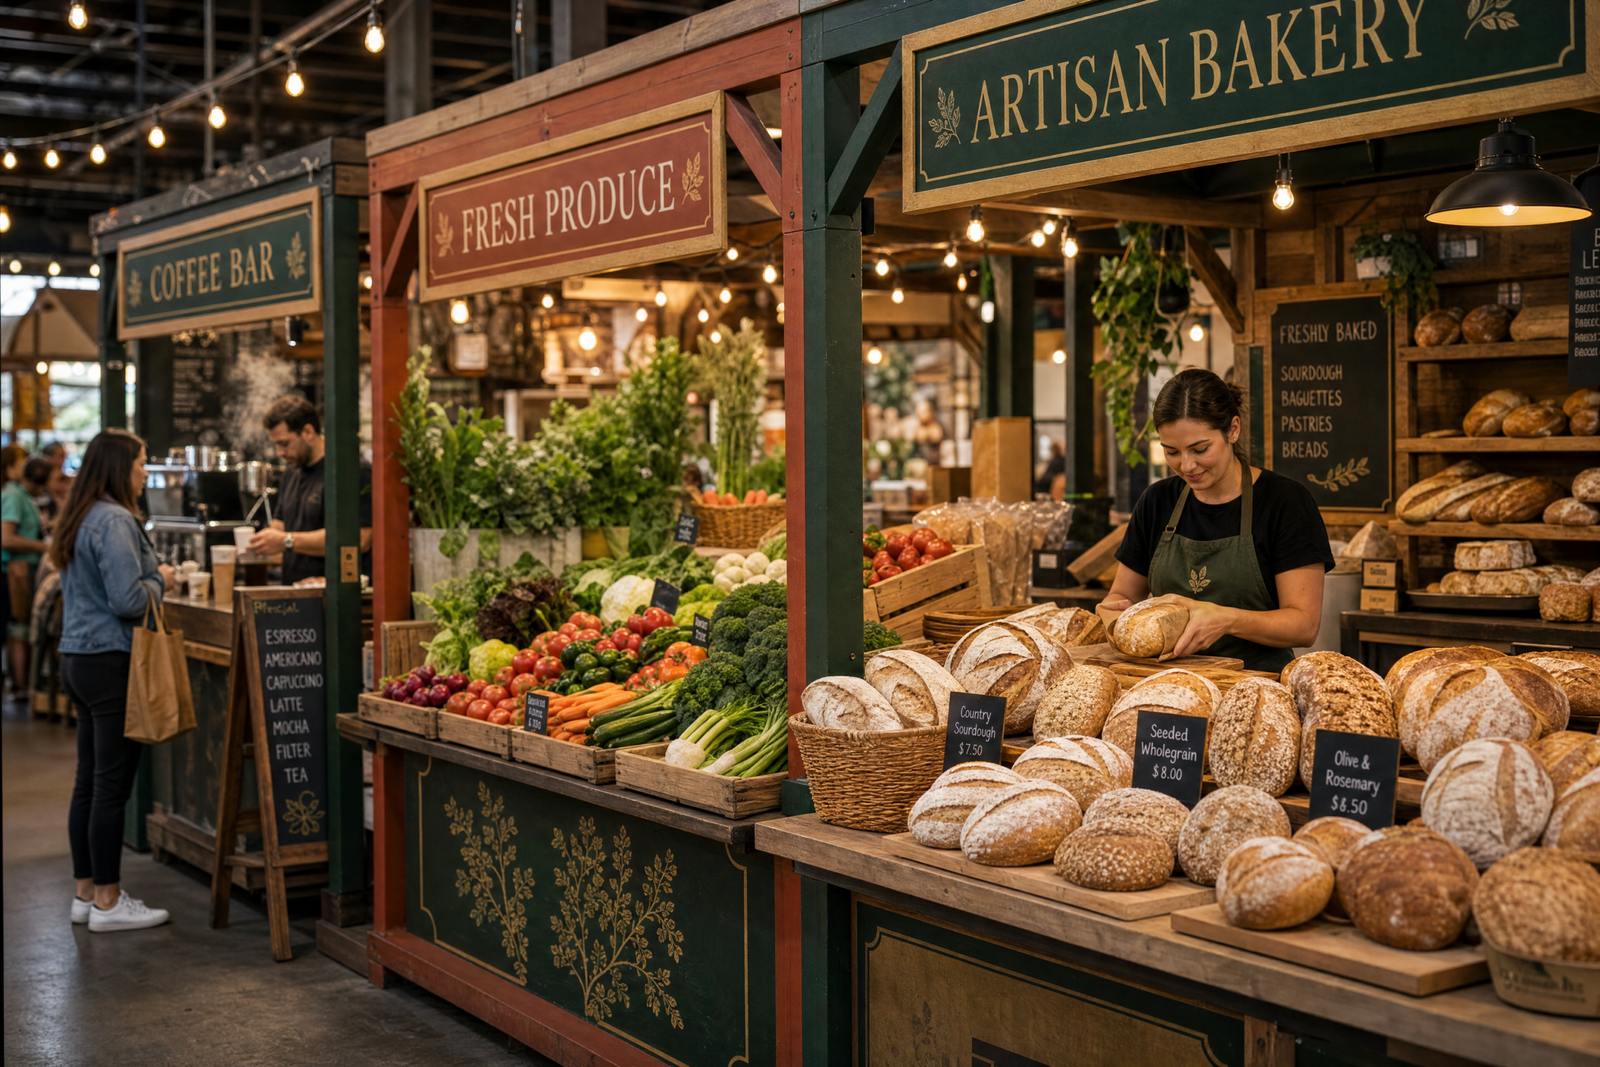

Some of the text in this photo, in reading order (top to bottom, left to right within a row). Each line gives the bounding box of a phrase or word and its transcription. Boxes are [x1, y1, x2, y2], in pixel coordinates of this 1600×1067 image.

[970, 0, 1425, 143] ARTISAN BAKERY
[461, 160, 675, 254] FRESH PRODUCE
[149, 241, 275, 303] COFFEE BAR
[1280, 321, 1377, 344] FRESHLY BAKED
[1281, 365, 1342, 381] SOURDOUGH
[1282, 390, 1342, 406] BAGUETTES
[1282, 416, 1332, 432] PASTRIES
[1283, 441, 1328, 458] BREADS
[265, 628, 316, 645] ESPRESSO
[265, 651, 321, 667] AMERICANO
[266, 674, 323, 690] CAPPUCCINO
[270, 697, 303, 713] LATTE
[960, 705, 992, 725] Country
[273, 719, 309, 735] MOCHA
[953, 721, 996, 742] Sourdough
[1150, 723, 1189, 743] Seeded
[276, 742, 311, 759] FILTER
[1141, 741, 1197, 764] Wholegrain
[1334, 750, 1371, 770] Olive &
[284, 767, 308, 783] TEA
[1325, 769, 1381, 798] Rosemary
